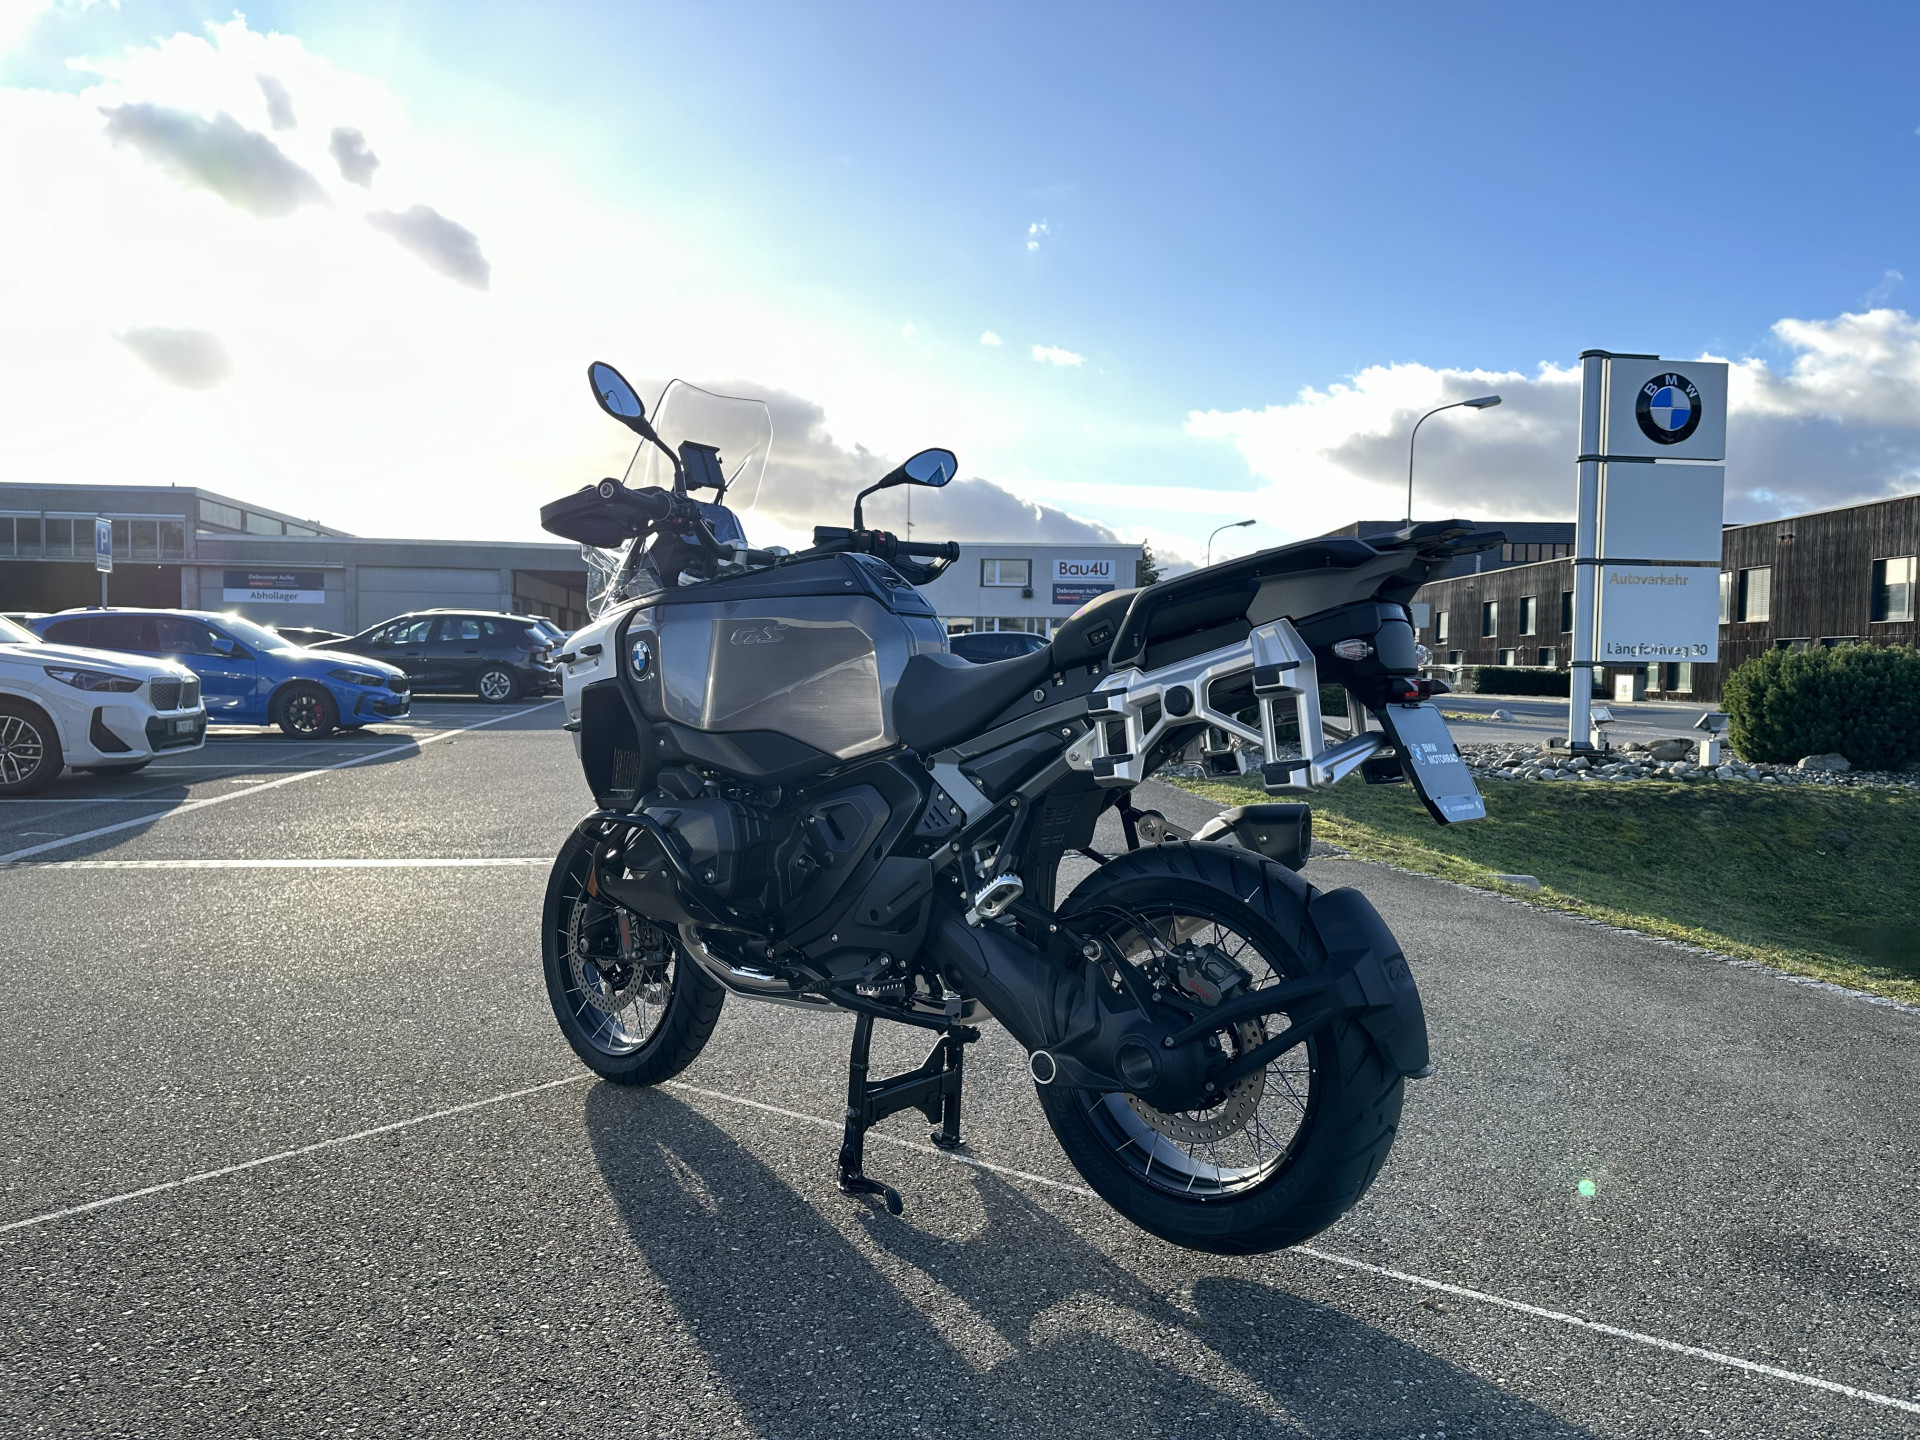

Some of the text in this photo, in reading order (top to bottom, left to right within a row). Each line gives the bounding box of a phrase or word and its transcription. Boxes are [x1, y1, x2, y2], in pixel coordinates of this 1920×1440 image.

[1644, 375, 1698, 398] BMW
[100, 527, 108, 551] P
[1059, 561, 1109, 576] Bau4U
[1609, 572, 1689, 586] Autoverkehr
[250, 591, 299, 602] Abhollager
[730, 625, 789, 646] GS
[1421, 742, 1438, 753] BMW
[1427, 754, 1459, 765] MOTORRAD
[1189, 980, 1212, 1000] BMW
